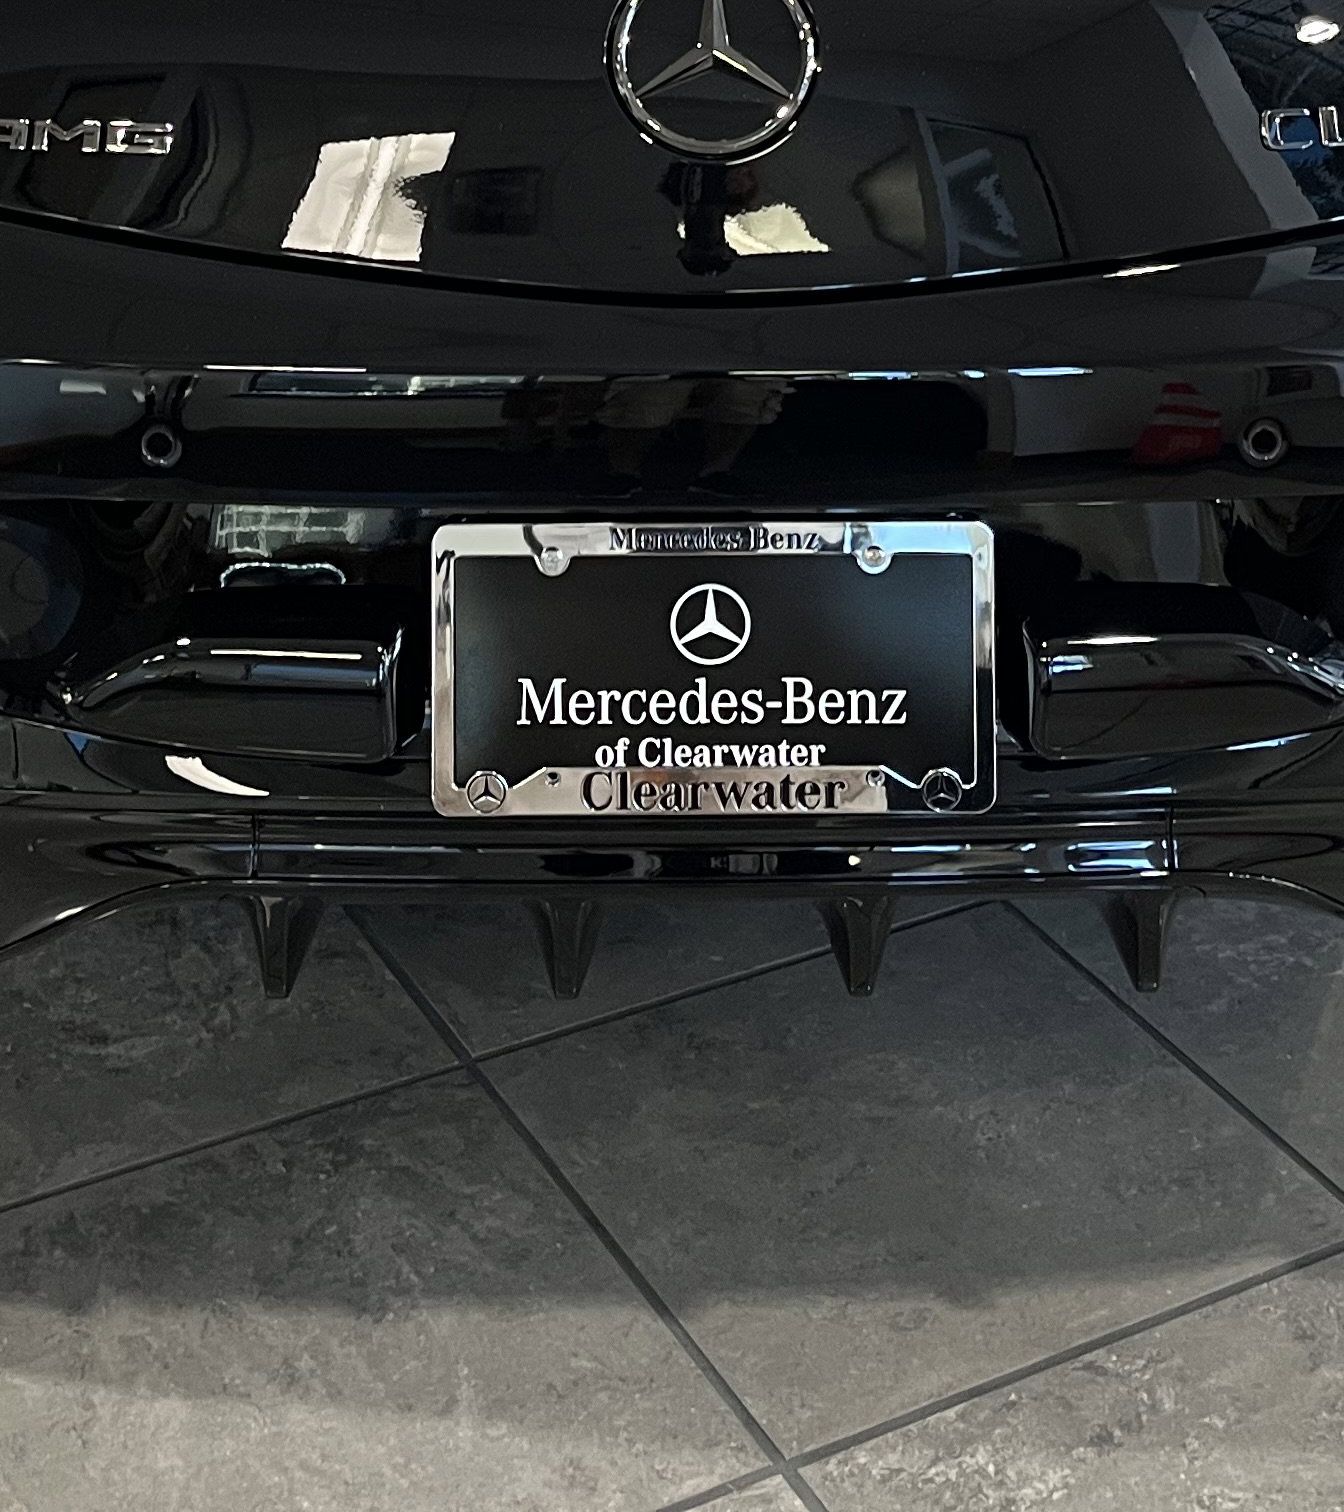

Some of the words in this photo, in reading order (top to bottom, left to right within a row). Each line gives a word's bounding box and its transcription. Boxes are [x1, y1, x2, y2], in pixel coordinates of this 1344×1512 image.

[516, 676, 908, 725] Mercedes-Benz
[594, 737, 630, 768] of
[637, 737, 827, 768] Clearwater
[580, 770, 847, 812] Clearwater
